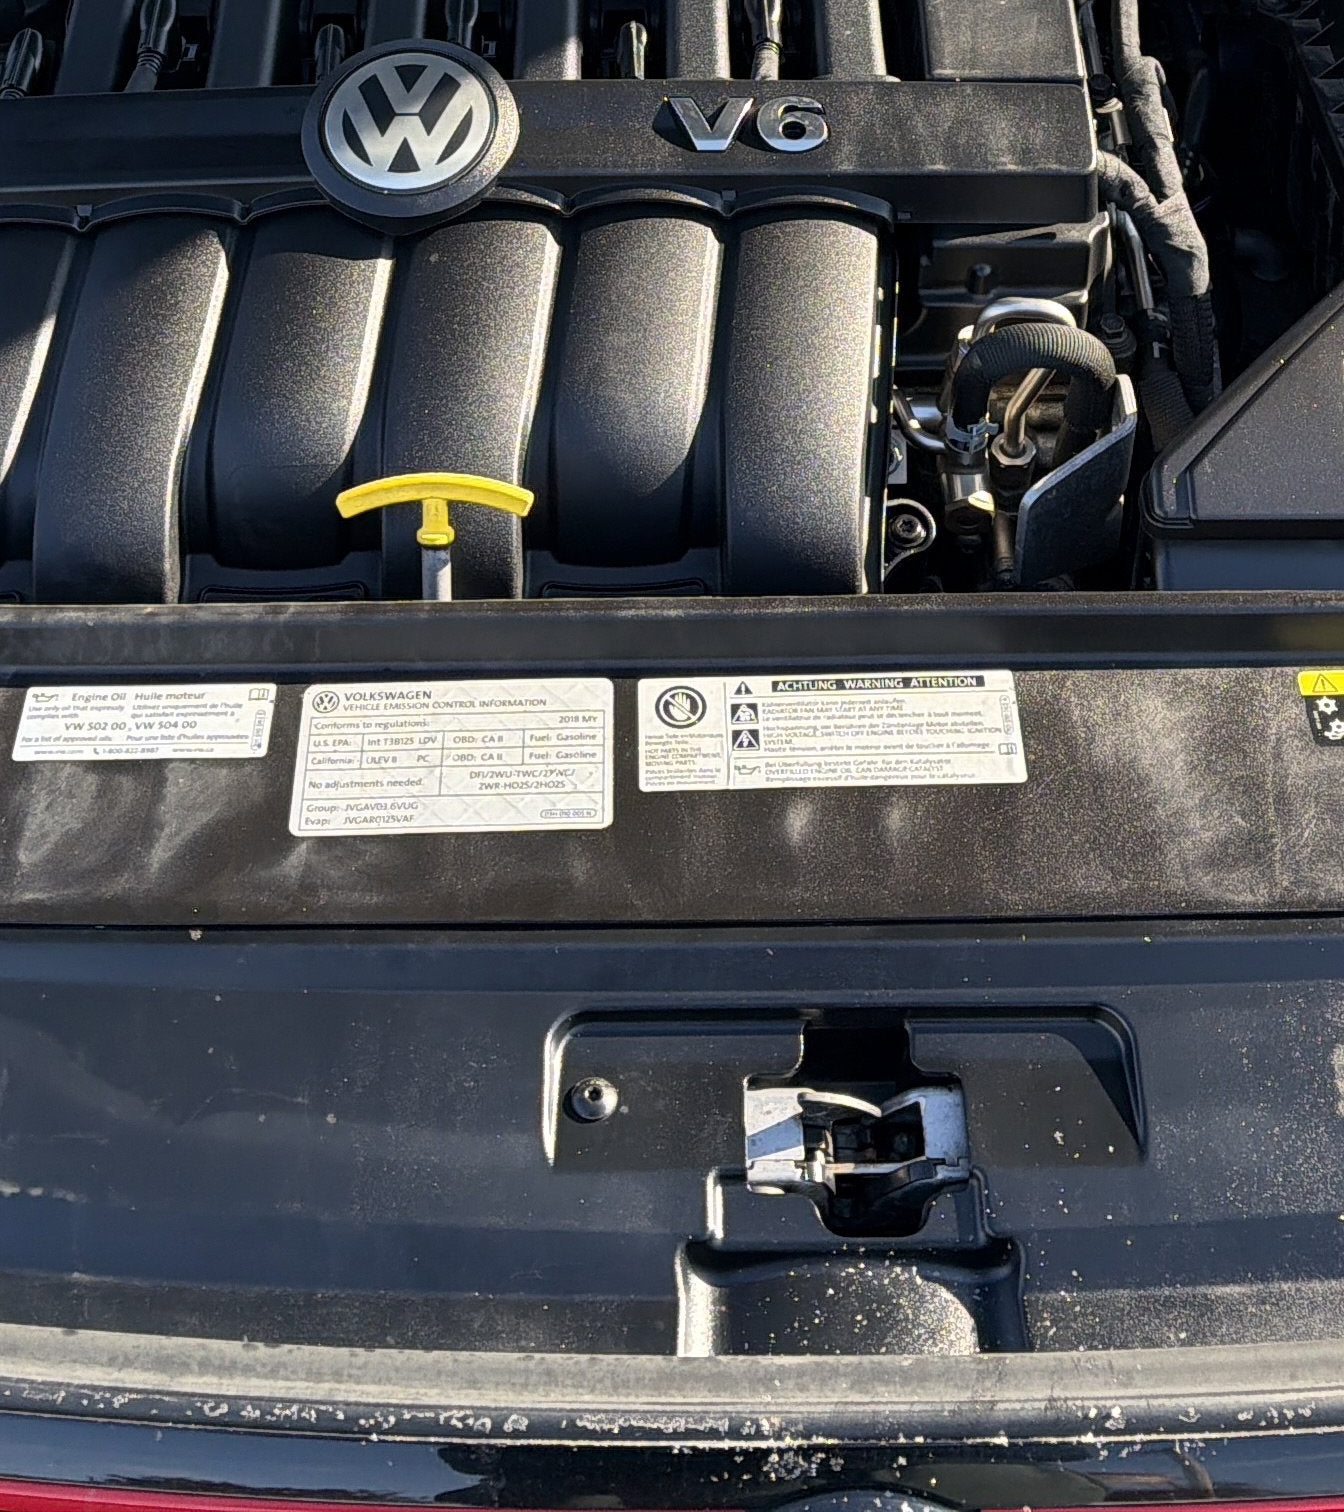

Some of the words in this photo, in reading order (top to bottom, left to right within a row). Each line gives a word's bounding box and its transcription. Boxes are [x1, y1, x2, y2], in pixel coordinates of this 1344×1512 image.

[665, 95, 828, 152] V6
[777, 681, 836, 691] ACHTUNG
[843, 678, 903, 689] WARNING
[910, 677, 976, 688] ATTENTION
[72, 693, 108, 703] Engine
[111, 692, 127, 701] Oil
[134, 692, 163, 701] Huile
[165, 692, 206, 700] moteur
[344, 690, 432, 702] VOLKSWAGEN
[343, 703, 380, 711] VEHICLE
[384, 702, 429, 711] EMISSION
[432, 700, 476, 709] CONTROL
[479, 699, 547, 708] INFORMATION
[64, 723, 85, 731] VW
[87, 722, 108, 731] 502
[134, 722, 155, 730] VW
[158, 721, 178, 730] 504
[181, 720, 197, 729] 00
[314, 721, 360, 730] Conforms
[453, 736, 477, 744] OBD:
[530, 734, 552, 742] Fuel:
[556, 733, 597, 741] Gasoline
[332, 739, 351, 747] EPA:
[416, 755, 430, 763] PC
[452, 754, 476, 762] OBD:
[481, 753, 495, 761] CA
[529, 752, 552, 760] Fuel:
[556, 751, 597, 759] Gasoline
[311, 757, 355, 765] California:
[308, 781, 322, 789] No
[325, 780, 384, 790] adjustments
[306, 804, 339, 814] Group:
[305, 817, 331, 826] Evap:
